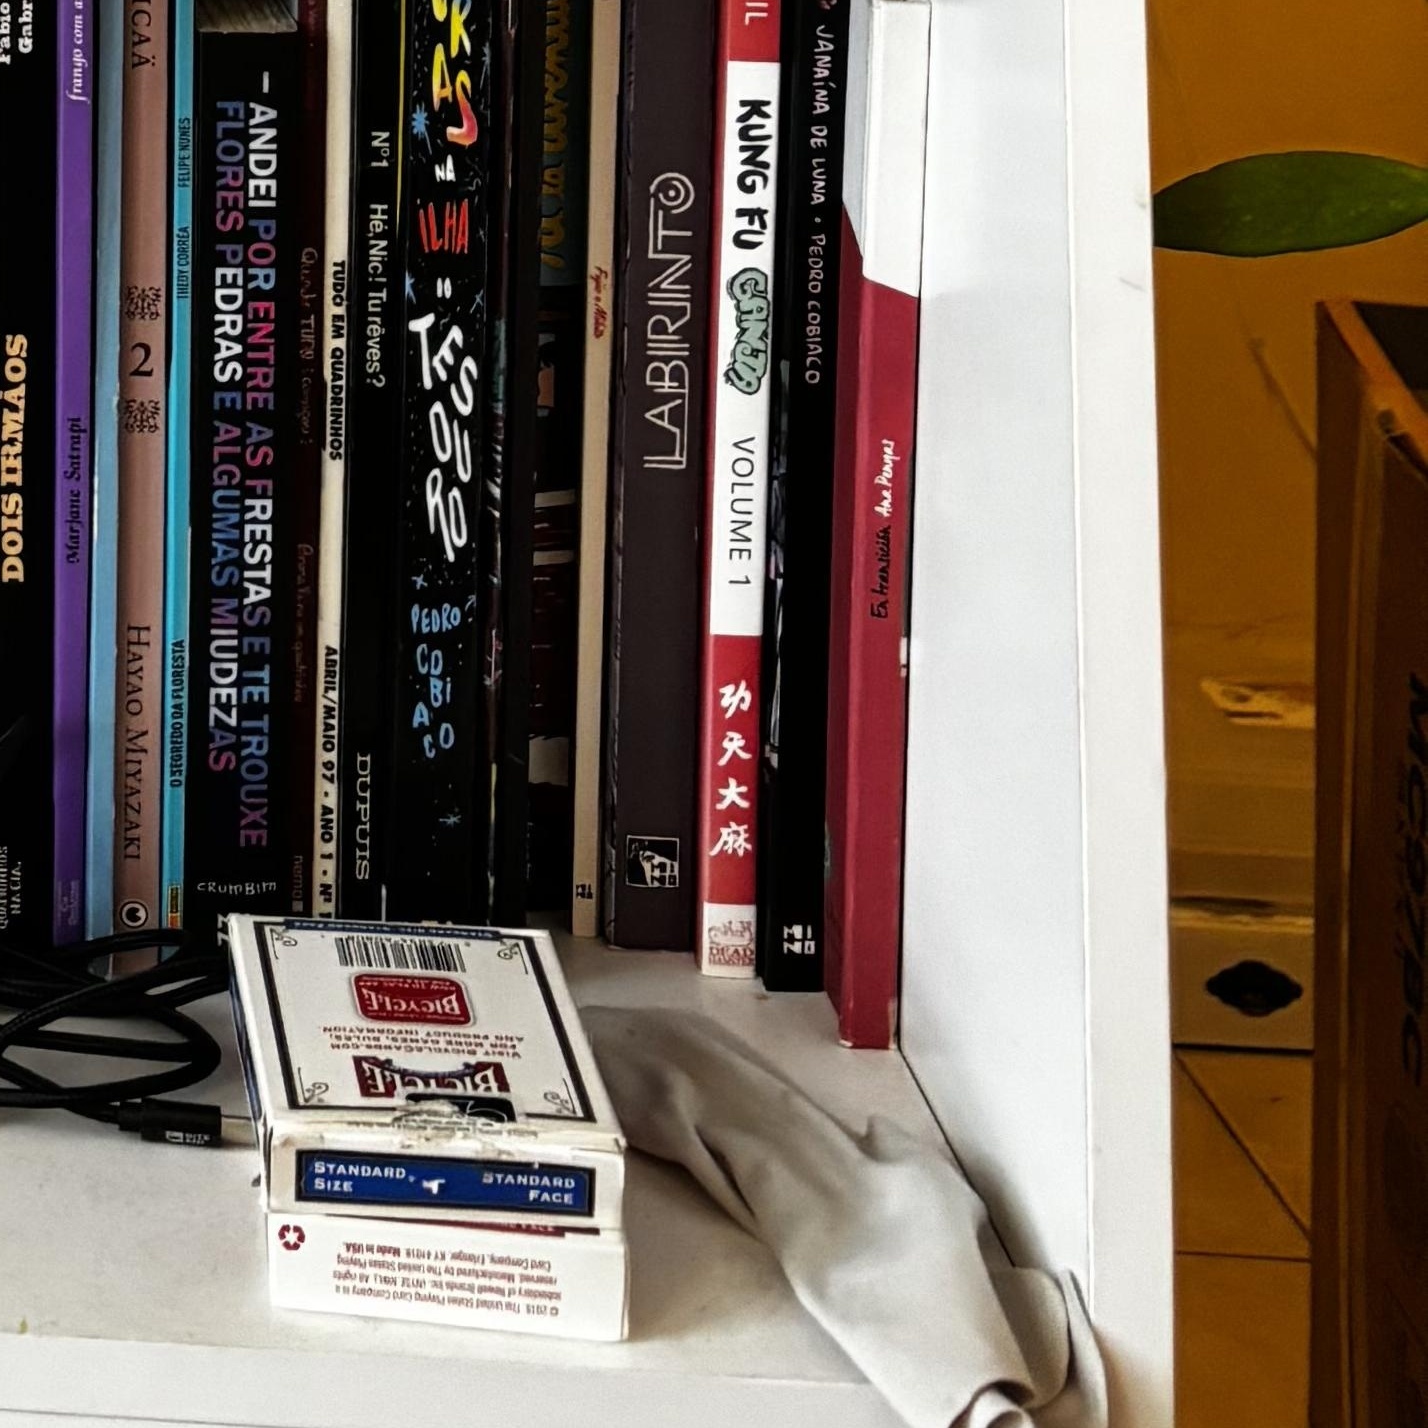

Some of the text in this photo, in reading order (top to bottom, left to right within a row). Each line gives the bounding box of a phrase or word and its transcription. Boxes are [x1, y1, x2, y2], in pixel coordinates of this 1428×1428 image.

[808, 24, 838, 116] JANAÍNA
[177, 153, 192, 189] FELIPE
[178, 117, 192, 152] NUNES
[735, 98, 774, 196] KUNG
[731, 206, 768, 252] FU
[805, 234, 826, 294] PEDRO
[643, 172, 694, 470] LABIRINTO
[803, 300, 824, 385] COBIACO
[209, 100, 245, 773] FLORES PEDRAS ALGUMAS MIUDEZAS
[327, 346, 344, 462] QUADRINHOS
[63, 417, 88, 565] Marjane Satrapi
[239, 101, 278, 848] ANDEI POR ENTRE AS FRESTAS TROUXE
[728, 436, 757, 562] VOLUME
[0, 493, 25, 584] DOIS
[354, 315, 388, 881] rêves? DUPUIS
[121, 621, 152, 864] HAYAO MIYAZAKI
[321, 644, 339, 754] ABRIL/MAIO
[313, 1177, 574, 1205] SIZE FACE
[314, 1160, 576, 1189] STANDARD STANDARD
